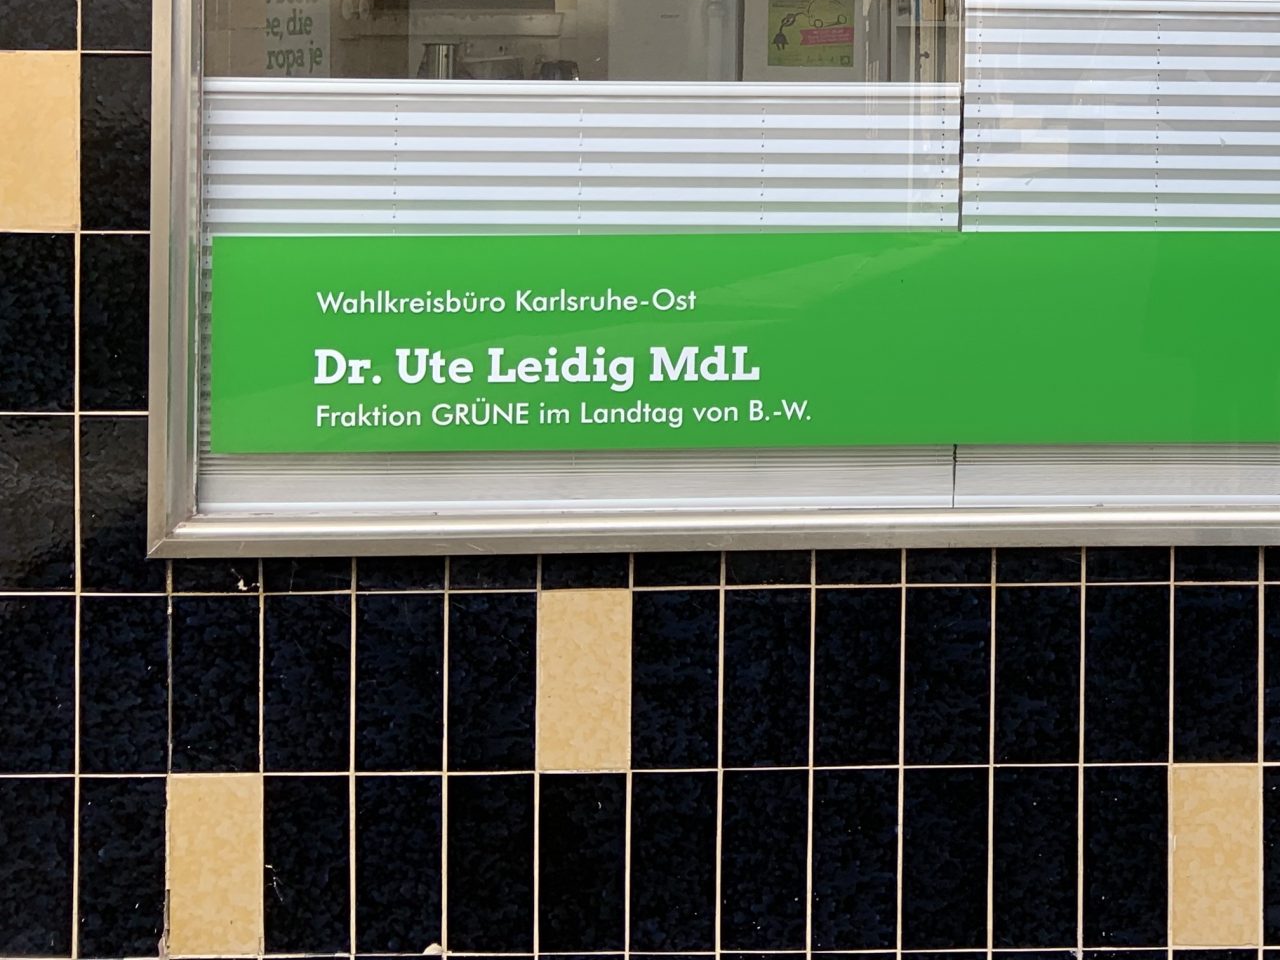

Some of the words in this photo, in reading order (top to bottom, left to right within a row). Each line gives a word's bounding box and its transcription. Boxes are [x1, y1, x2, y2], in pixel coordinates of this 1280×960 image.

[286, 8, 313, 36] die
[266, 48, 305, 76] ropa
[308, 40, 323, 74] je
[316, 289, 506, 315] Wahlkreisbüro
[515, 288, 697, 312] Karlsruhe-Ost
[313, 348, 383, 385] Dr.
[395, 347, 475, 384] Ute
[487, 345, 635, 392] Leidig
[649, 345, 761, 382] MdL
[316, 404, 422, 428] Fraktion
[431, 397, 530, 426] GRÜNE
[539, 402, 571, 425] im
[580, 399, 684, 429] Landtag
[692, 405, 740, 422] von
[749, 399, 812, 422] B.-W.
